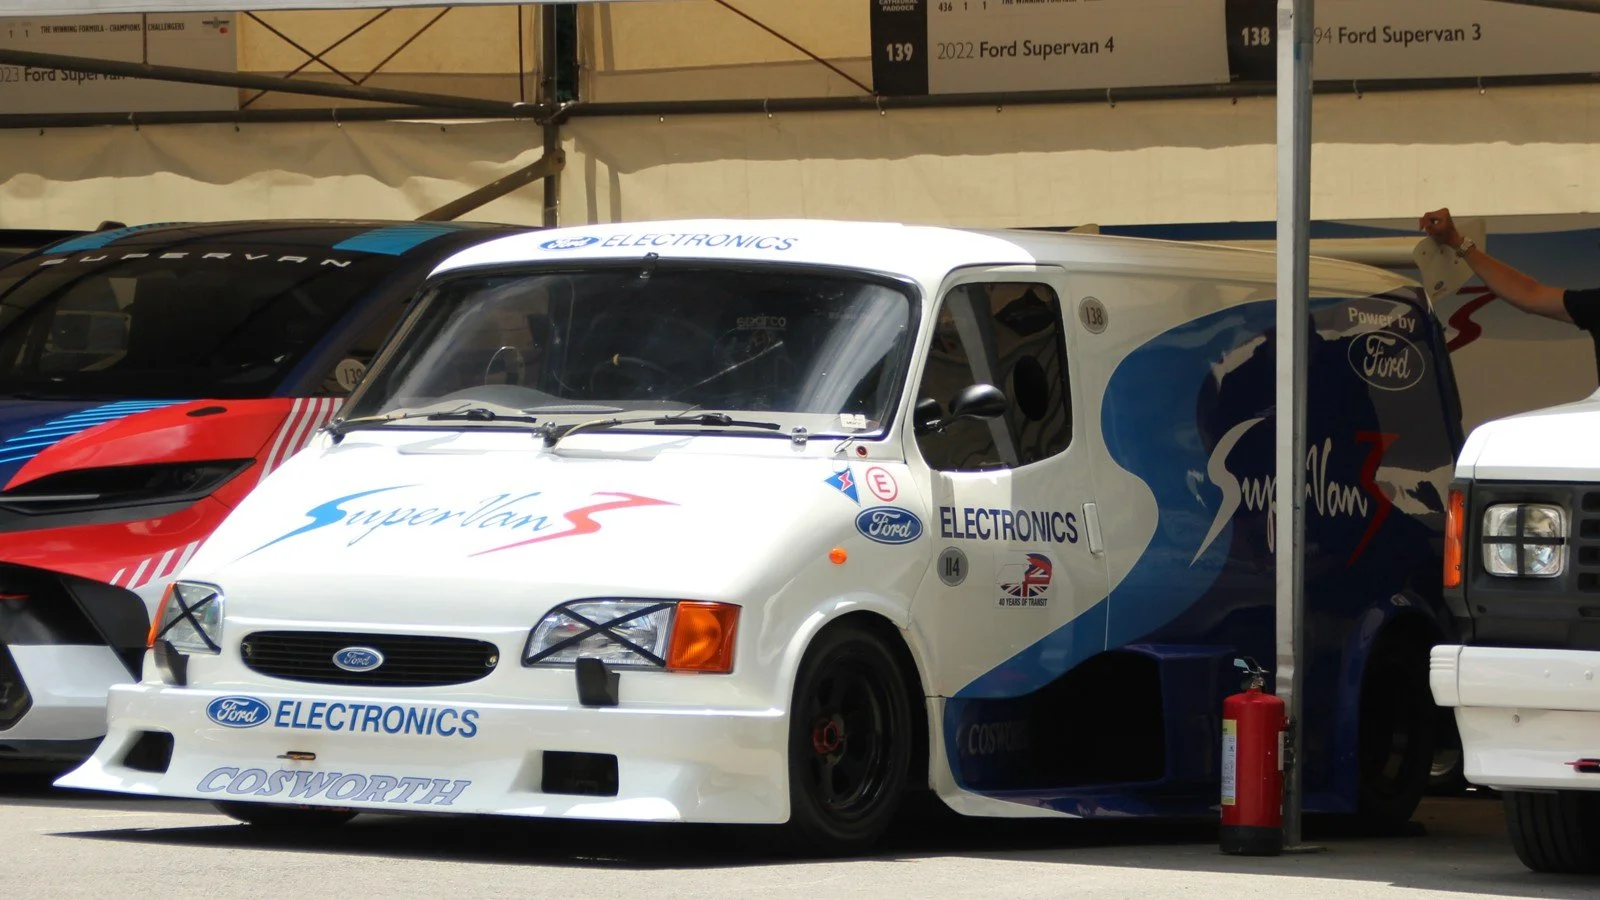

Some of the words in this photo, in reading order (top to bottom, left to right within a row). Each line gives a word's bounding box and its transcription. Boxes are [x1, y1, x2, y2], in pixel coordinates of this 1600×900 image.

[938, 2, 952, 12] 436
[41, 26, 51, 34] THE
[53, 25, 78, 33] WINNING
[79, 25, 104, 33] FORMULA
[109, 23, 140, 32] CHAMPIONS
[147, 22, 185, 31] CHALLENGERS
[1338, 26, 1376, 44] Ford
[1382, 25, 1465, 47] Supervan
[1471, 24, 1482, 41] 3
[1241, 27, 1270, 46] 138
[886, 43, 913, 62] 139
[937, 42, 974, 60] 2022
[979, 40, 1017, 58] Ford
[1023, 41, 1099, 60] Supervan
[1104, 37, 1115, 53] 4
[24, 66, 56, 82] Ford
[601, 234, 799, 250] ELECTRONICS
[39, 252, 352, 267] SUPERVAN
[1085, 306, 1104, 326] 138
[1347, 307, 1392, 328] Power
[1398, 313, 1416, 333] by
[1363, 335, 1411, 379] Ford
[939, 506, 1079, 544] ELECTRONICS
[1006, 598, 1021, 606] YEARS
[1022, 598, 1028, 606] OF
[1029, 597, 1048, 607] TRANSIT
[274, 700, 480, 738] ELECTRONICS
[196, 766, 472, 805] COSWORTH
